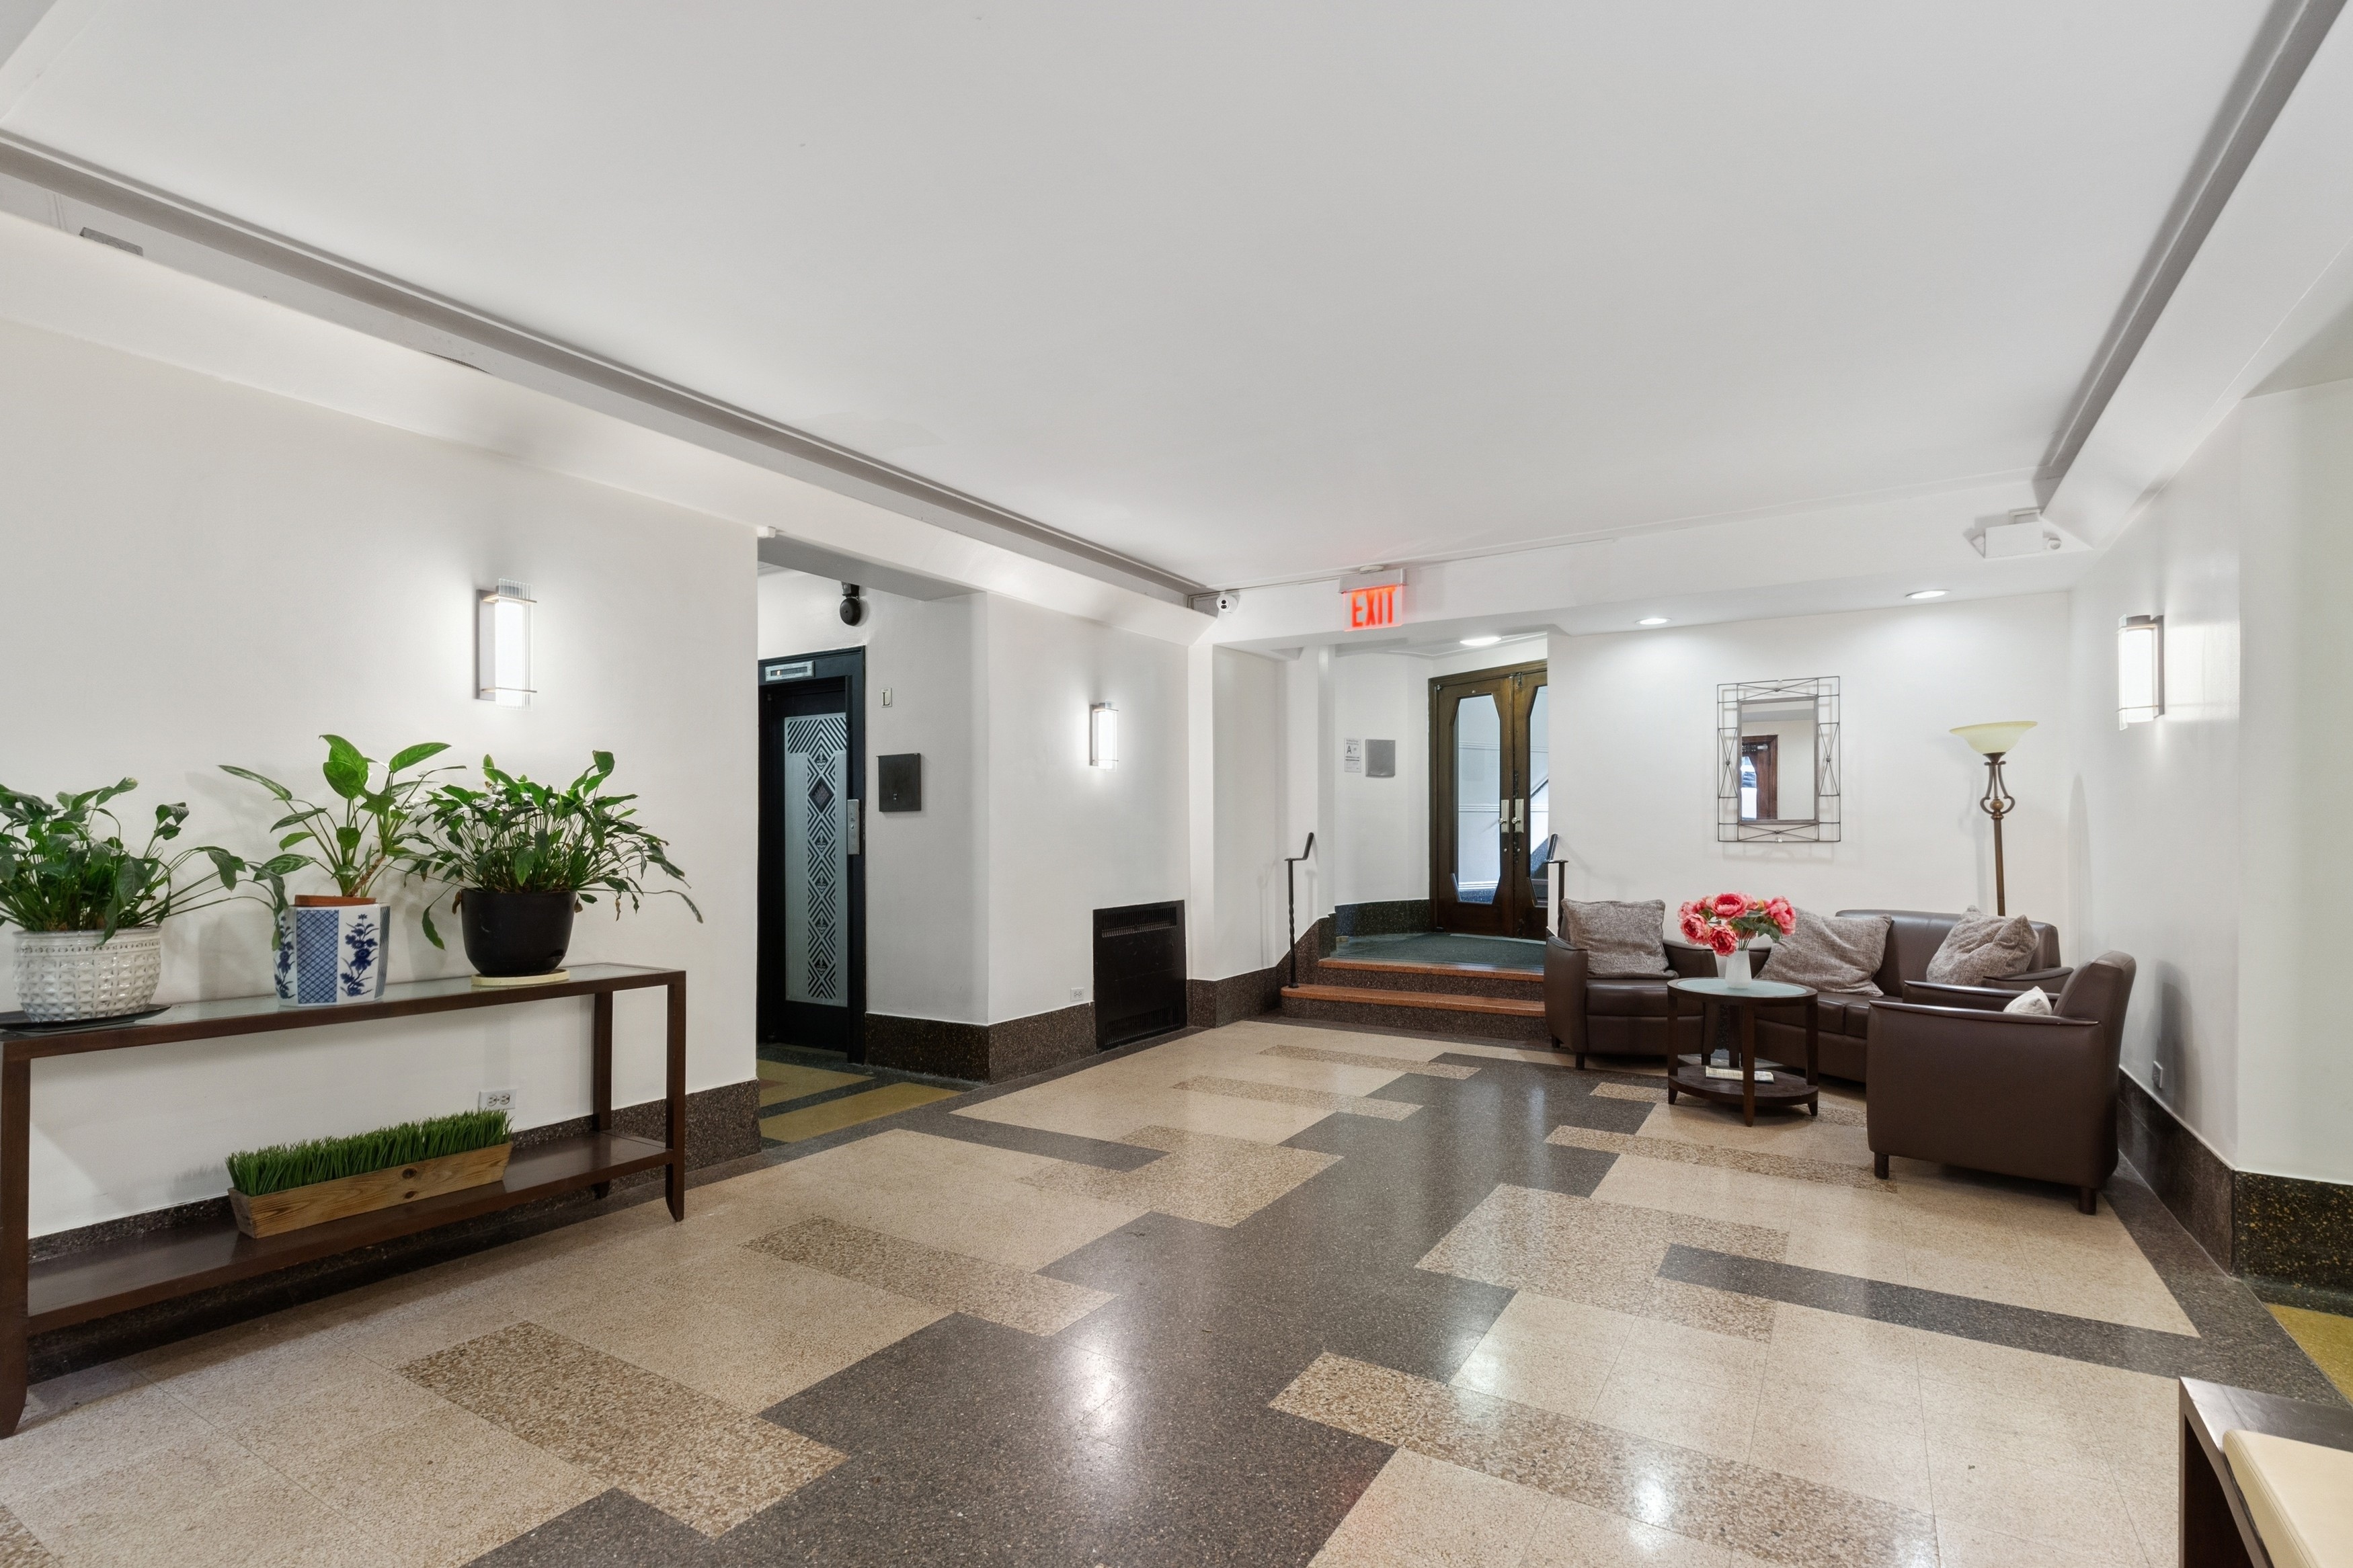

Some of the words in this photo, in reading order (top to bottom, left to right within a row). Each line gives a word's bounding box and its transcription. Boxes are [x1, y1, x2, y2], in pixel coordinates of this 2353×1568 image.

[1351, 587, 1396, 627] EXIT
[882, 692, 890, 706] L
[1347, 745, 1352, 753] A
